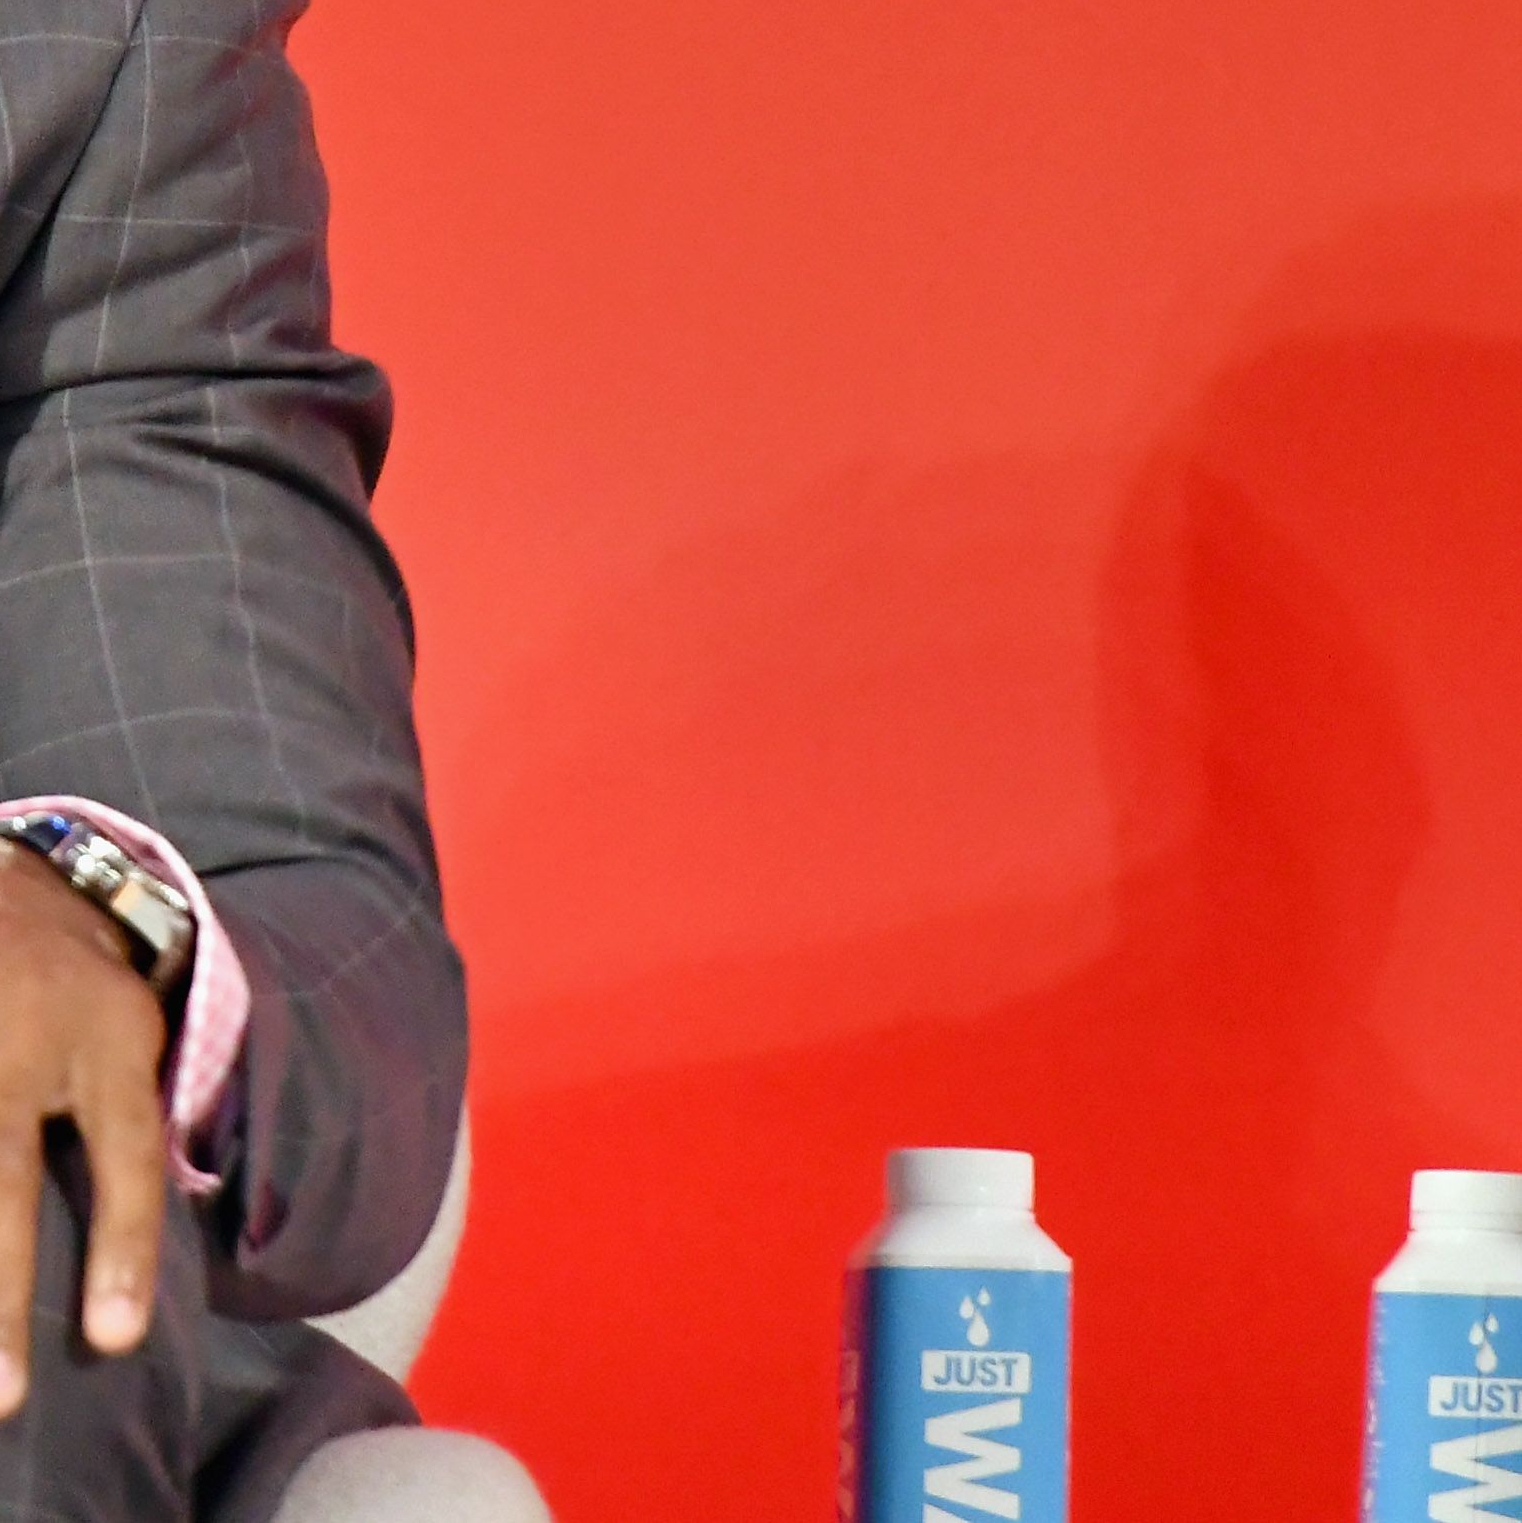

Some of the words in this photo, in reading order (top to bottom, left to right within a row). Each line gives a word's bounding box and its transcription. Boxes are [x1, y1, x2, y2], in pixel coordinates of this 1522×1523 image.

[933, 1356, 1018, 1387] JUST
[1440, 1382, 1522, 1413] JUST
[924, 1398, 1021, 1523] W
